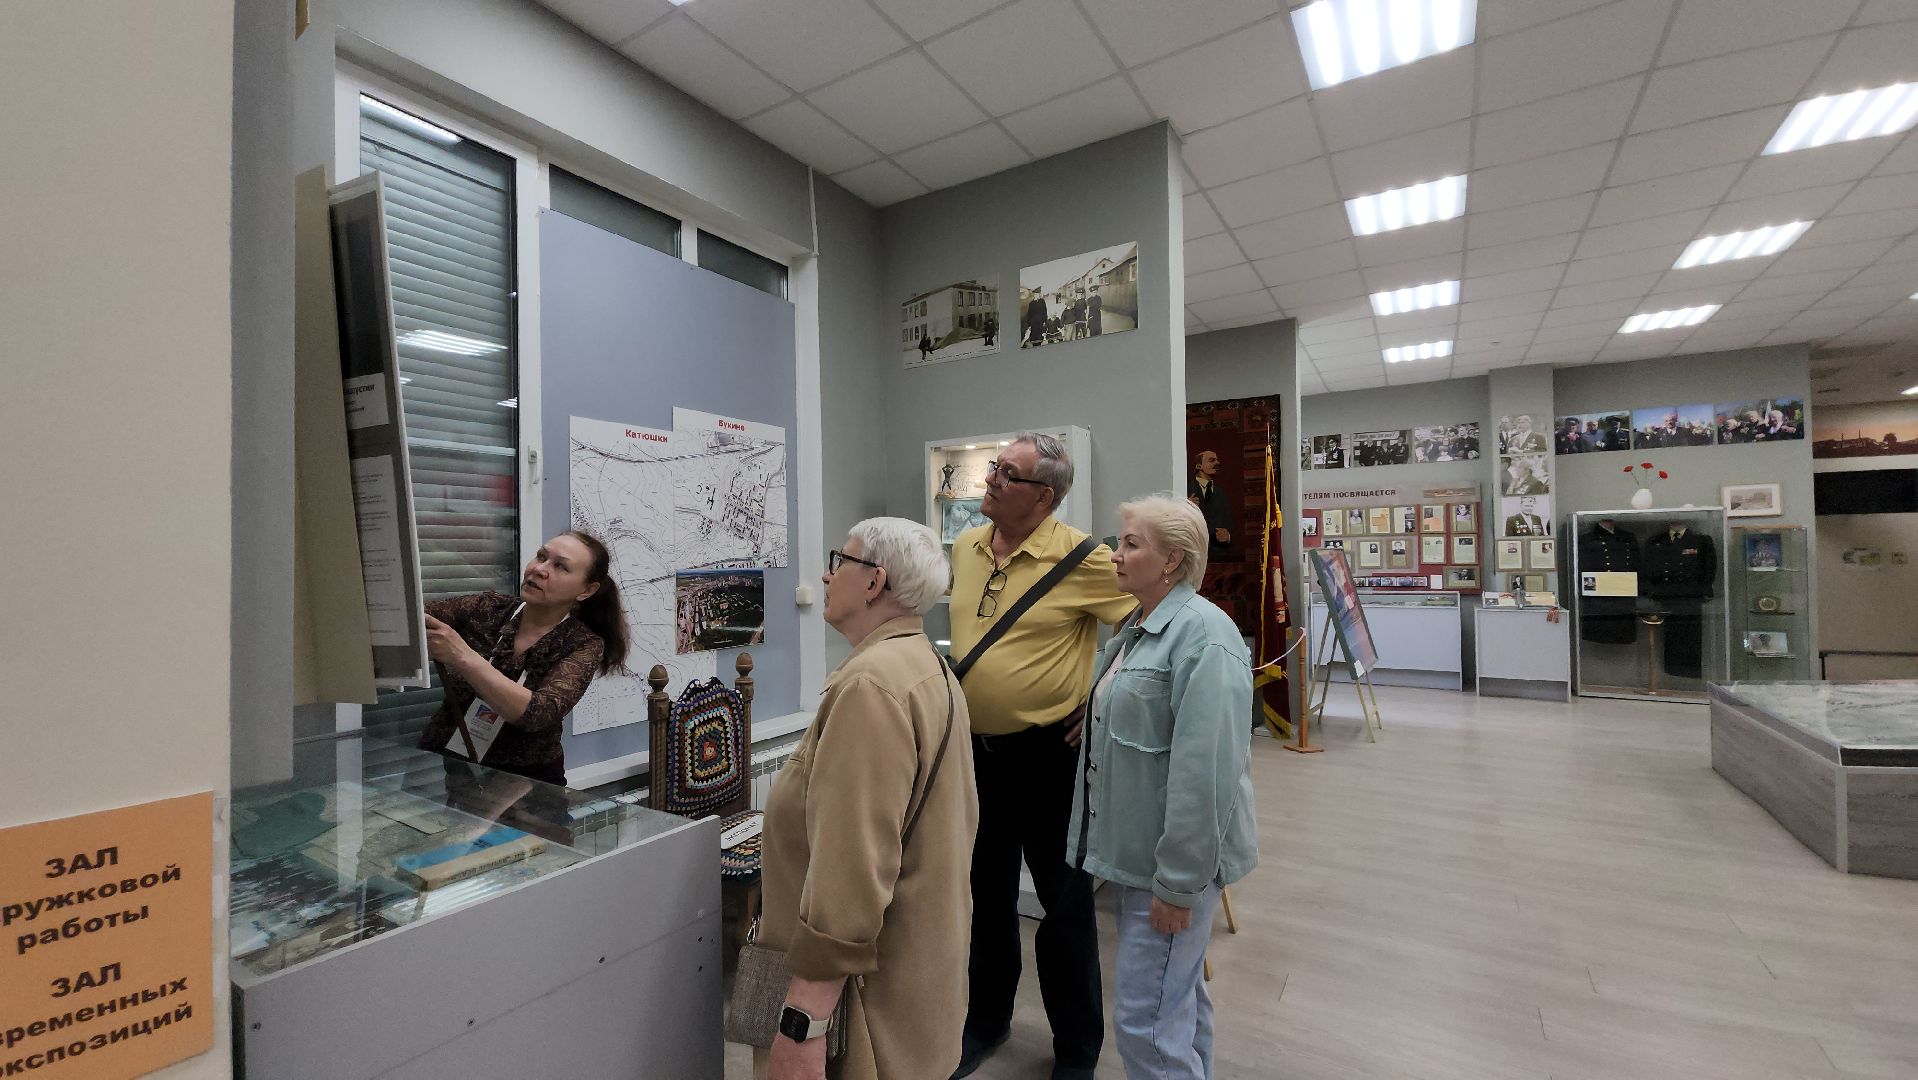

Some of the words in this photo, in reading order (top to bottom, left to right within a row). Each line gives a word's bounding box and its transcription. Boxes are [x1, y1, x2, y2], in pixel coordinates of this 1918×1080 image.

[625, 429, 668, 443] Катюшки
[1333, 489, 1396, 498] ПОСВЯЩАЕТСЯ
[45, 846, 118, 878] ЗАЛ
[0, 864, 181, 926] ружковой
[17, 905, 149, 955] работы
[51, 962, 122, 998] ЗАЛ
